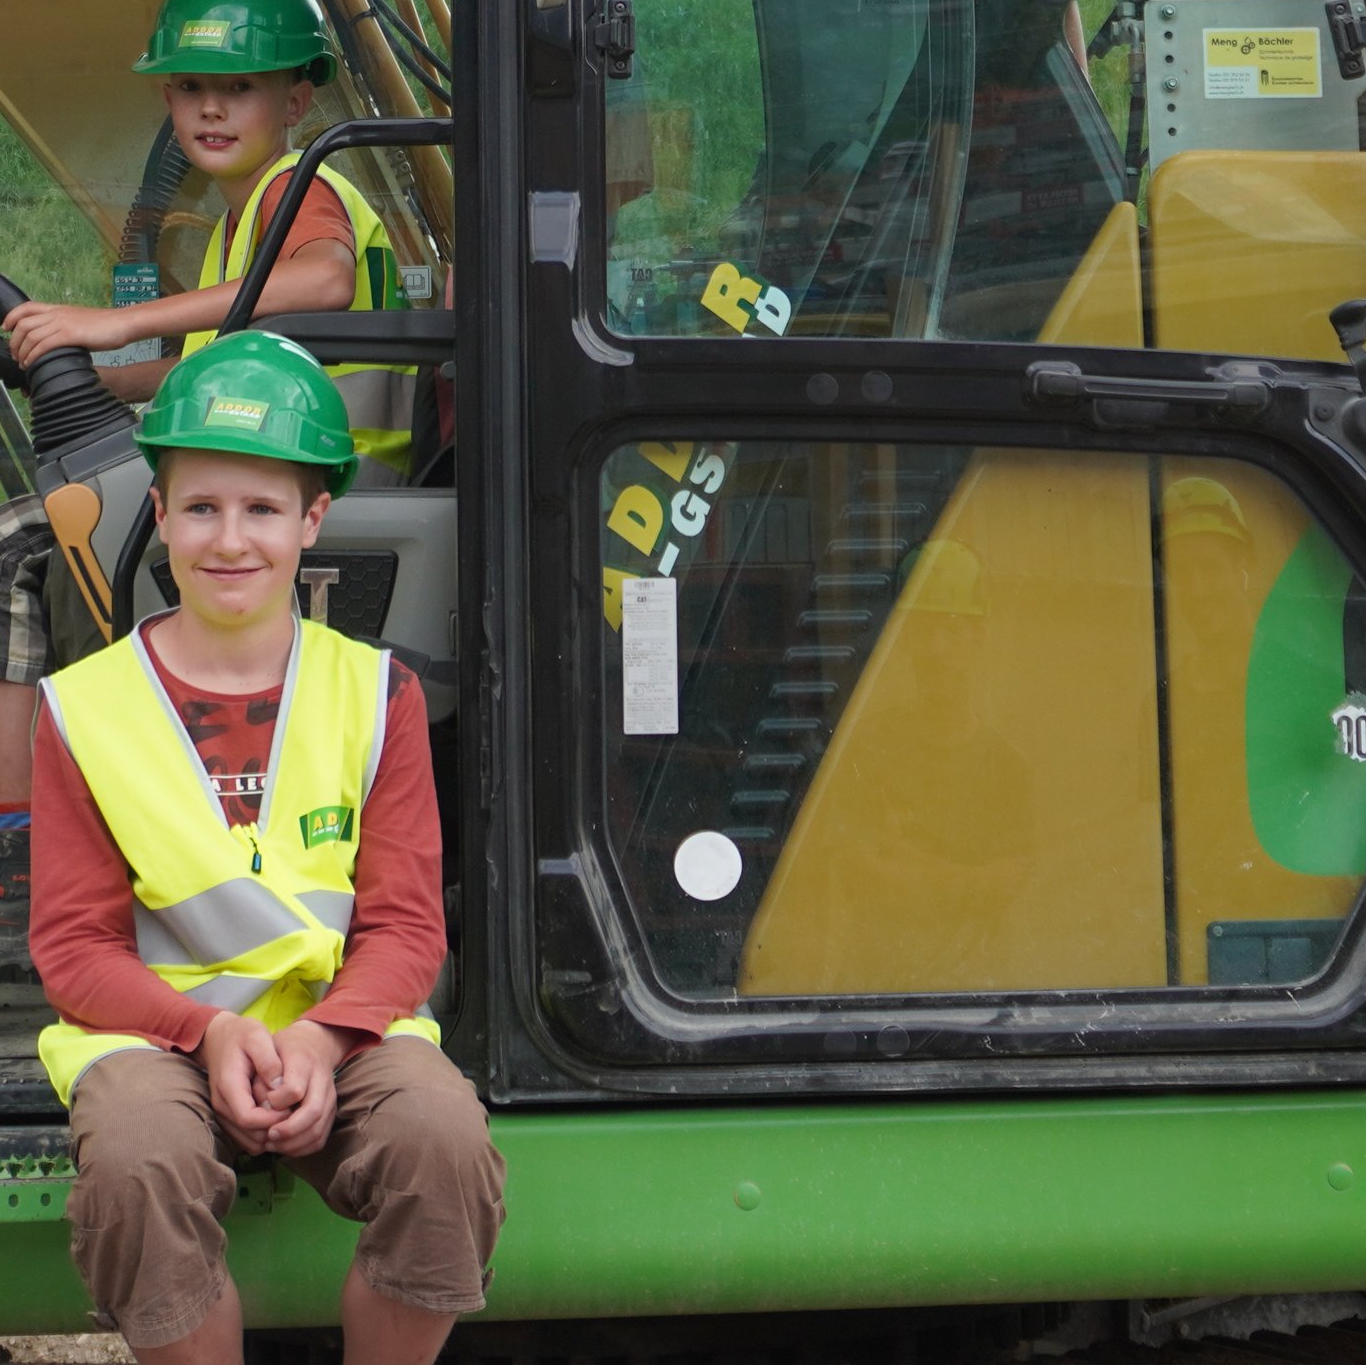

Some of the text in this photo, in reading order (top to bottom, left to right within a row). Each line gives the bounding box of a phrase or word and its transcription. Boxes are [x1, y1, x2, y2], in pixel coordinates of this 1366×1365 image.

[1211, 37, 1293, 47] Meng Bächler
[217, 403, 262, 415] ADDOR
